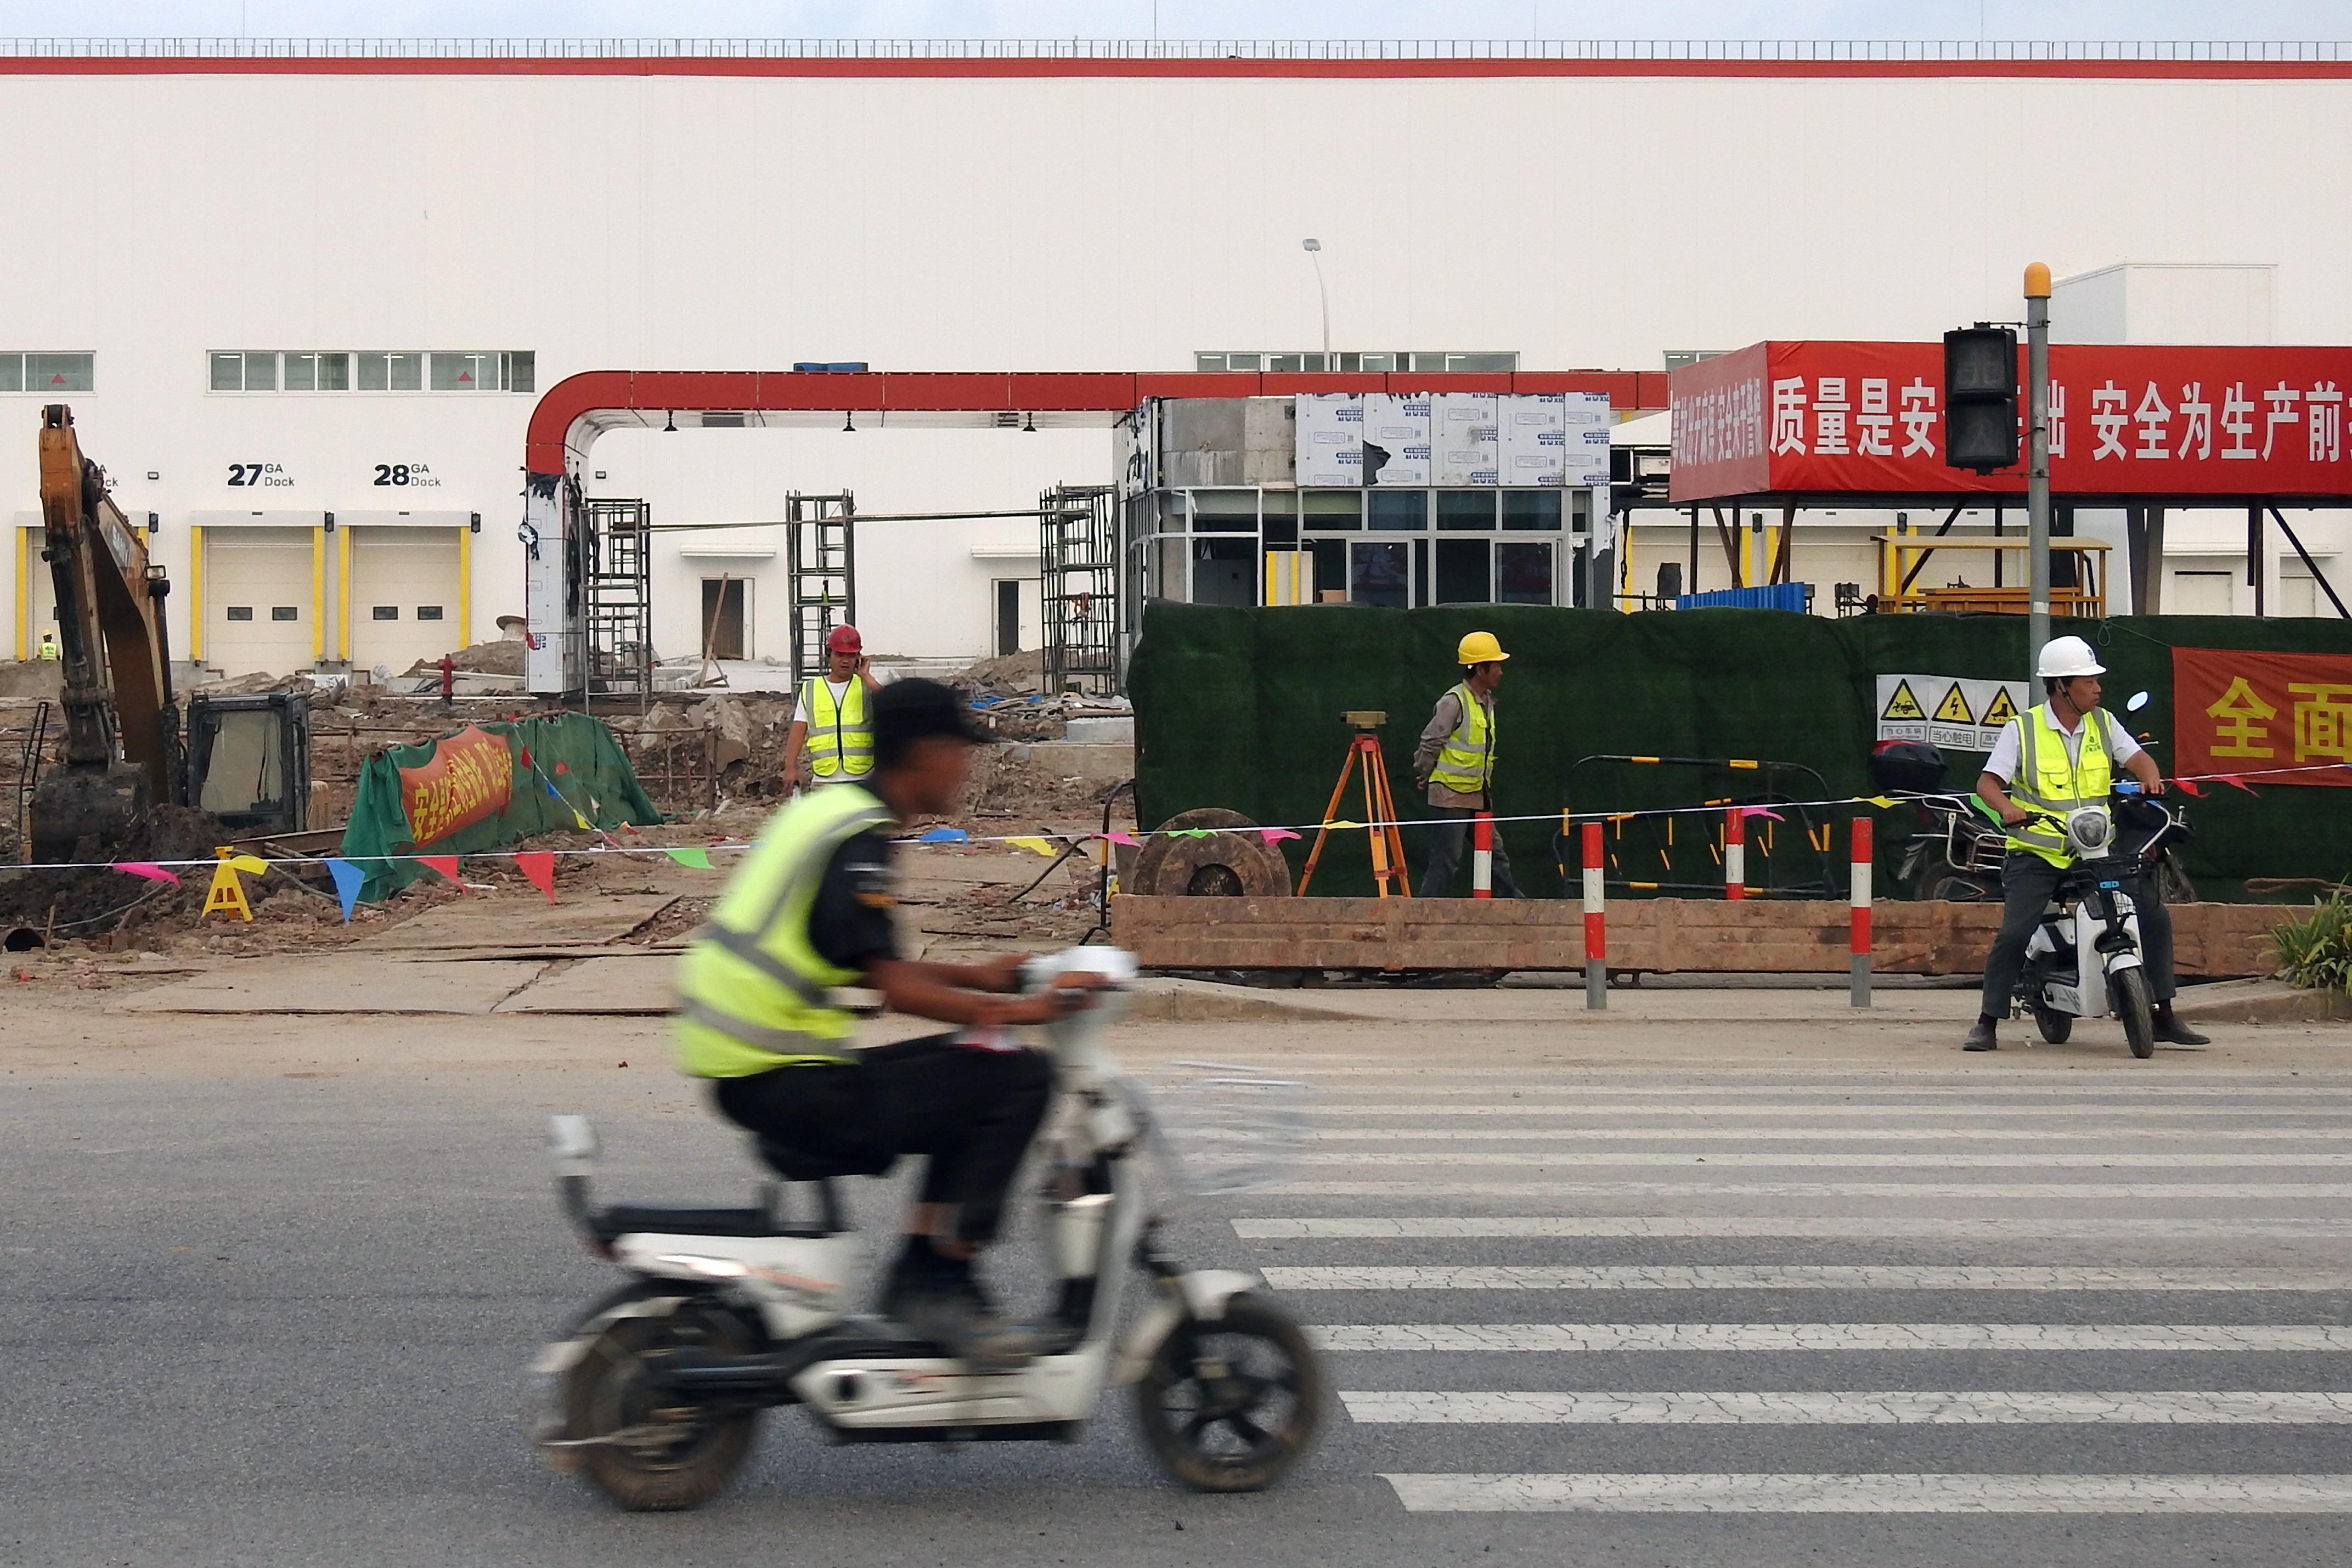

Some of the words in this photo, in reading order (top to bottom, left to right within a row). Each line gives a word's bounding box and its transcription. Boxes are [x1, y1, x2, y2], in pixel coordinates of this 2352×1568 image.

[2091, 380, 2352, 462] 安全为生产前
[228, 464, 263, 486] 27
[264, 463, 283, 473] GA
[374, 464, 410, 486] 28
[410, 464, 430, 473] GA
[264, 477, 295, 487] Dock
[411, 477, 441, 487] Dock
[2206, 676, 2352, 763] 全面
[1932, 730, 1972, 745] 当心触电
